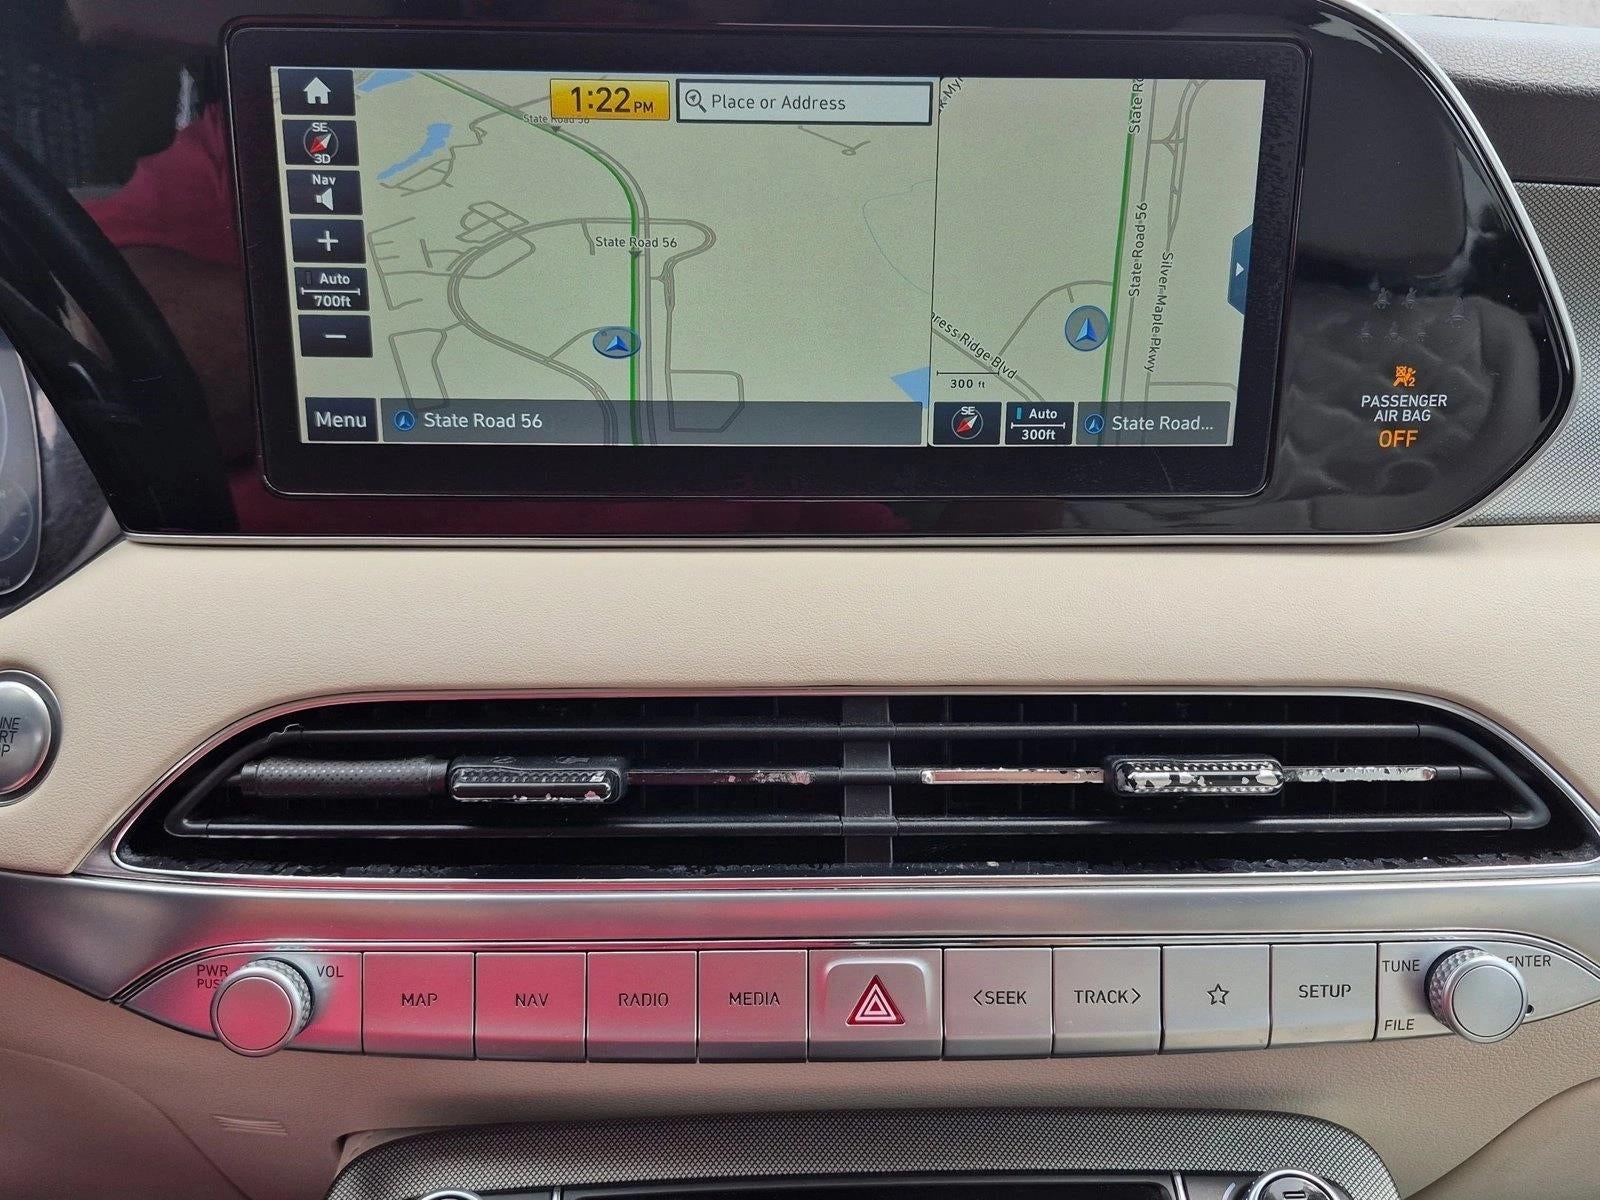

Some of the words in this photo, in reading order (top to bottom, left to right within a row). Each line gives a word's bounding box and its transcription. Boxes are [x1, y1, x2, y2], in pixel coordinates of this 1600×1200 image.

[570, 86, 631, 113] 1:22
[634, 101, 654, 113] PM
[711, 94, 755, 110] Place
[760, 98, 775, 110] or
[780, 95, 847, 111] Address
[523, 113, 549, 124] State
[1128, 97, 1143, 134] State
[311, 122, 328, 133] SE
[314, 154, 331, 165] 3D
[312, 174, 336, 186] Nav
[1135, 202, 1148, 220] 56
[596, 236, 626, 248] State
[630, 236, 659, 249] Road
[662, 237, 678, 249] 56
[1132, 224, 1146, 258] Road
[1158, 252, 1174, 291] Silver
[319, 273, 351, 285] Auto
[1129, 262, 1142, 297] State
[314, 295, 352, 308] 700ft
[1152, 295, 1167, 334] Maple
[959, 332, 991, 361] Ridge
[991, 356, 1018, 379] Blvd
[1144, 337, 1162, 373] Pkwy
[950, 379, 974, 389] 300
[978, 380, 986, 389] ft
[1361, 394, 1448, 408] PASSENGER
[960, 406, 976, 415] SE
[1029, 409, 1058, 420] Auto
[1374, 409, 1398, 422] AIR
[1402, 409, 1431, 422] BAG
[314, 411, 368, 428] Menu
[424, 412, 469, 428] State
[473, 413, 516, 428] Road
[521, 413, 543, 428] 56
[1112, 416, 1155, 431] State
[1021, 429, 1056, 441] 300ft
[1378, 429, 1419, 448] OFF
[0, 730, 18, 743] RT
[0, 744, 10, 757] P
[1382, 960, 1421, 973] TUNE
[1506, 954, 1552, 968] ENTER
[197, 964, 229, 977] PWR
[316, 965, 344, 978] VOL
[197, 978, 224, 989] PUS
[1298, 984, 1352, 998] SETUP
[401, 992, 438, 1008] MAP
[514, 993, 549, 1008] NAV
[618, 992, 669, 1007] RADIO
[729, 991, 780, 1006] MEDIA
[1384, 1018, 1415, 1031] FILE
